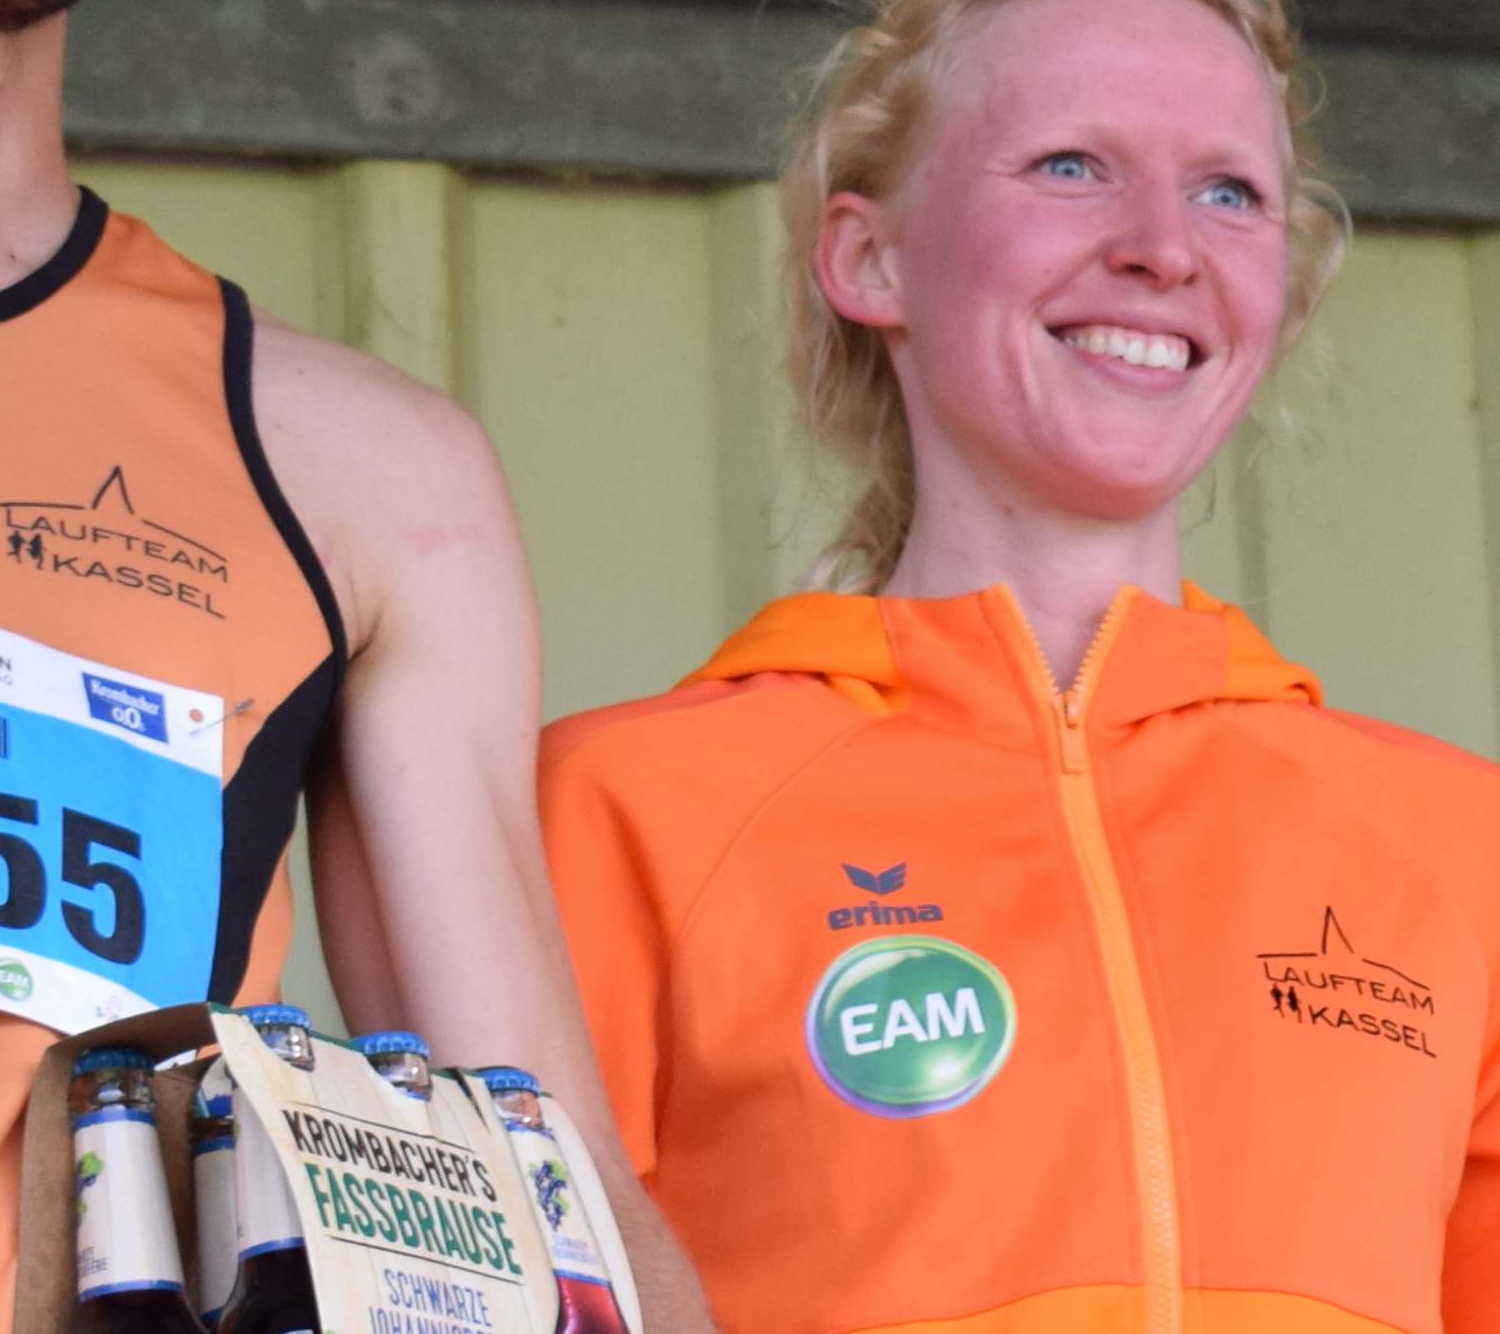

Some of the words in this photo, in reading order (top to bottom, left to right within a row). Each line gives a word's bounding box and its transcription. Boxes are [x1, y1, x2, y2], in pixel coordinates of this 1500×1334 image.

[5, 505, 228, 584] LAUFTEAM
[52, 553, 227, 620] KASSEL
[827, 899, 944, 932] erima
[839, 986, 987, 1057] EAM
[1262, 960, 1437, 1016] LAUFTEAM
[1307, 1003, 1438, 1060] KASSEL
[281, 1108, 499, 1204] KROMBACHER'S
[303, 1161, 525, 1277] FASSBRAUSE
[382, 1268, 494, 1328] SCHWARZE
